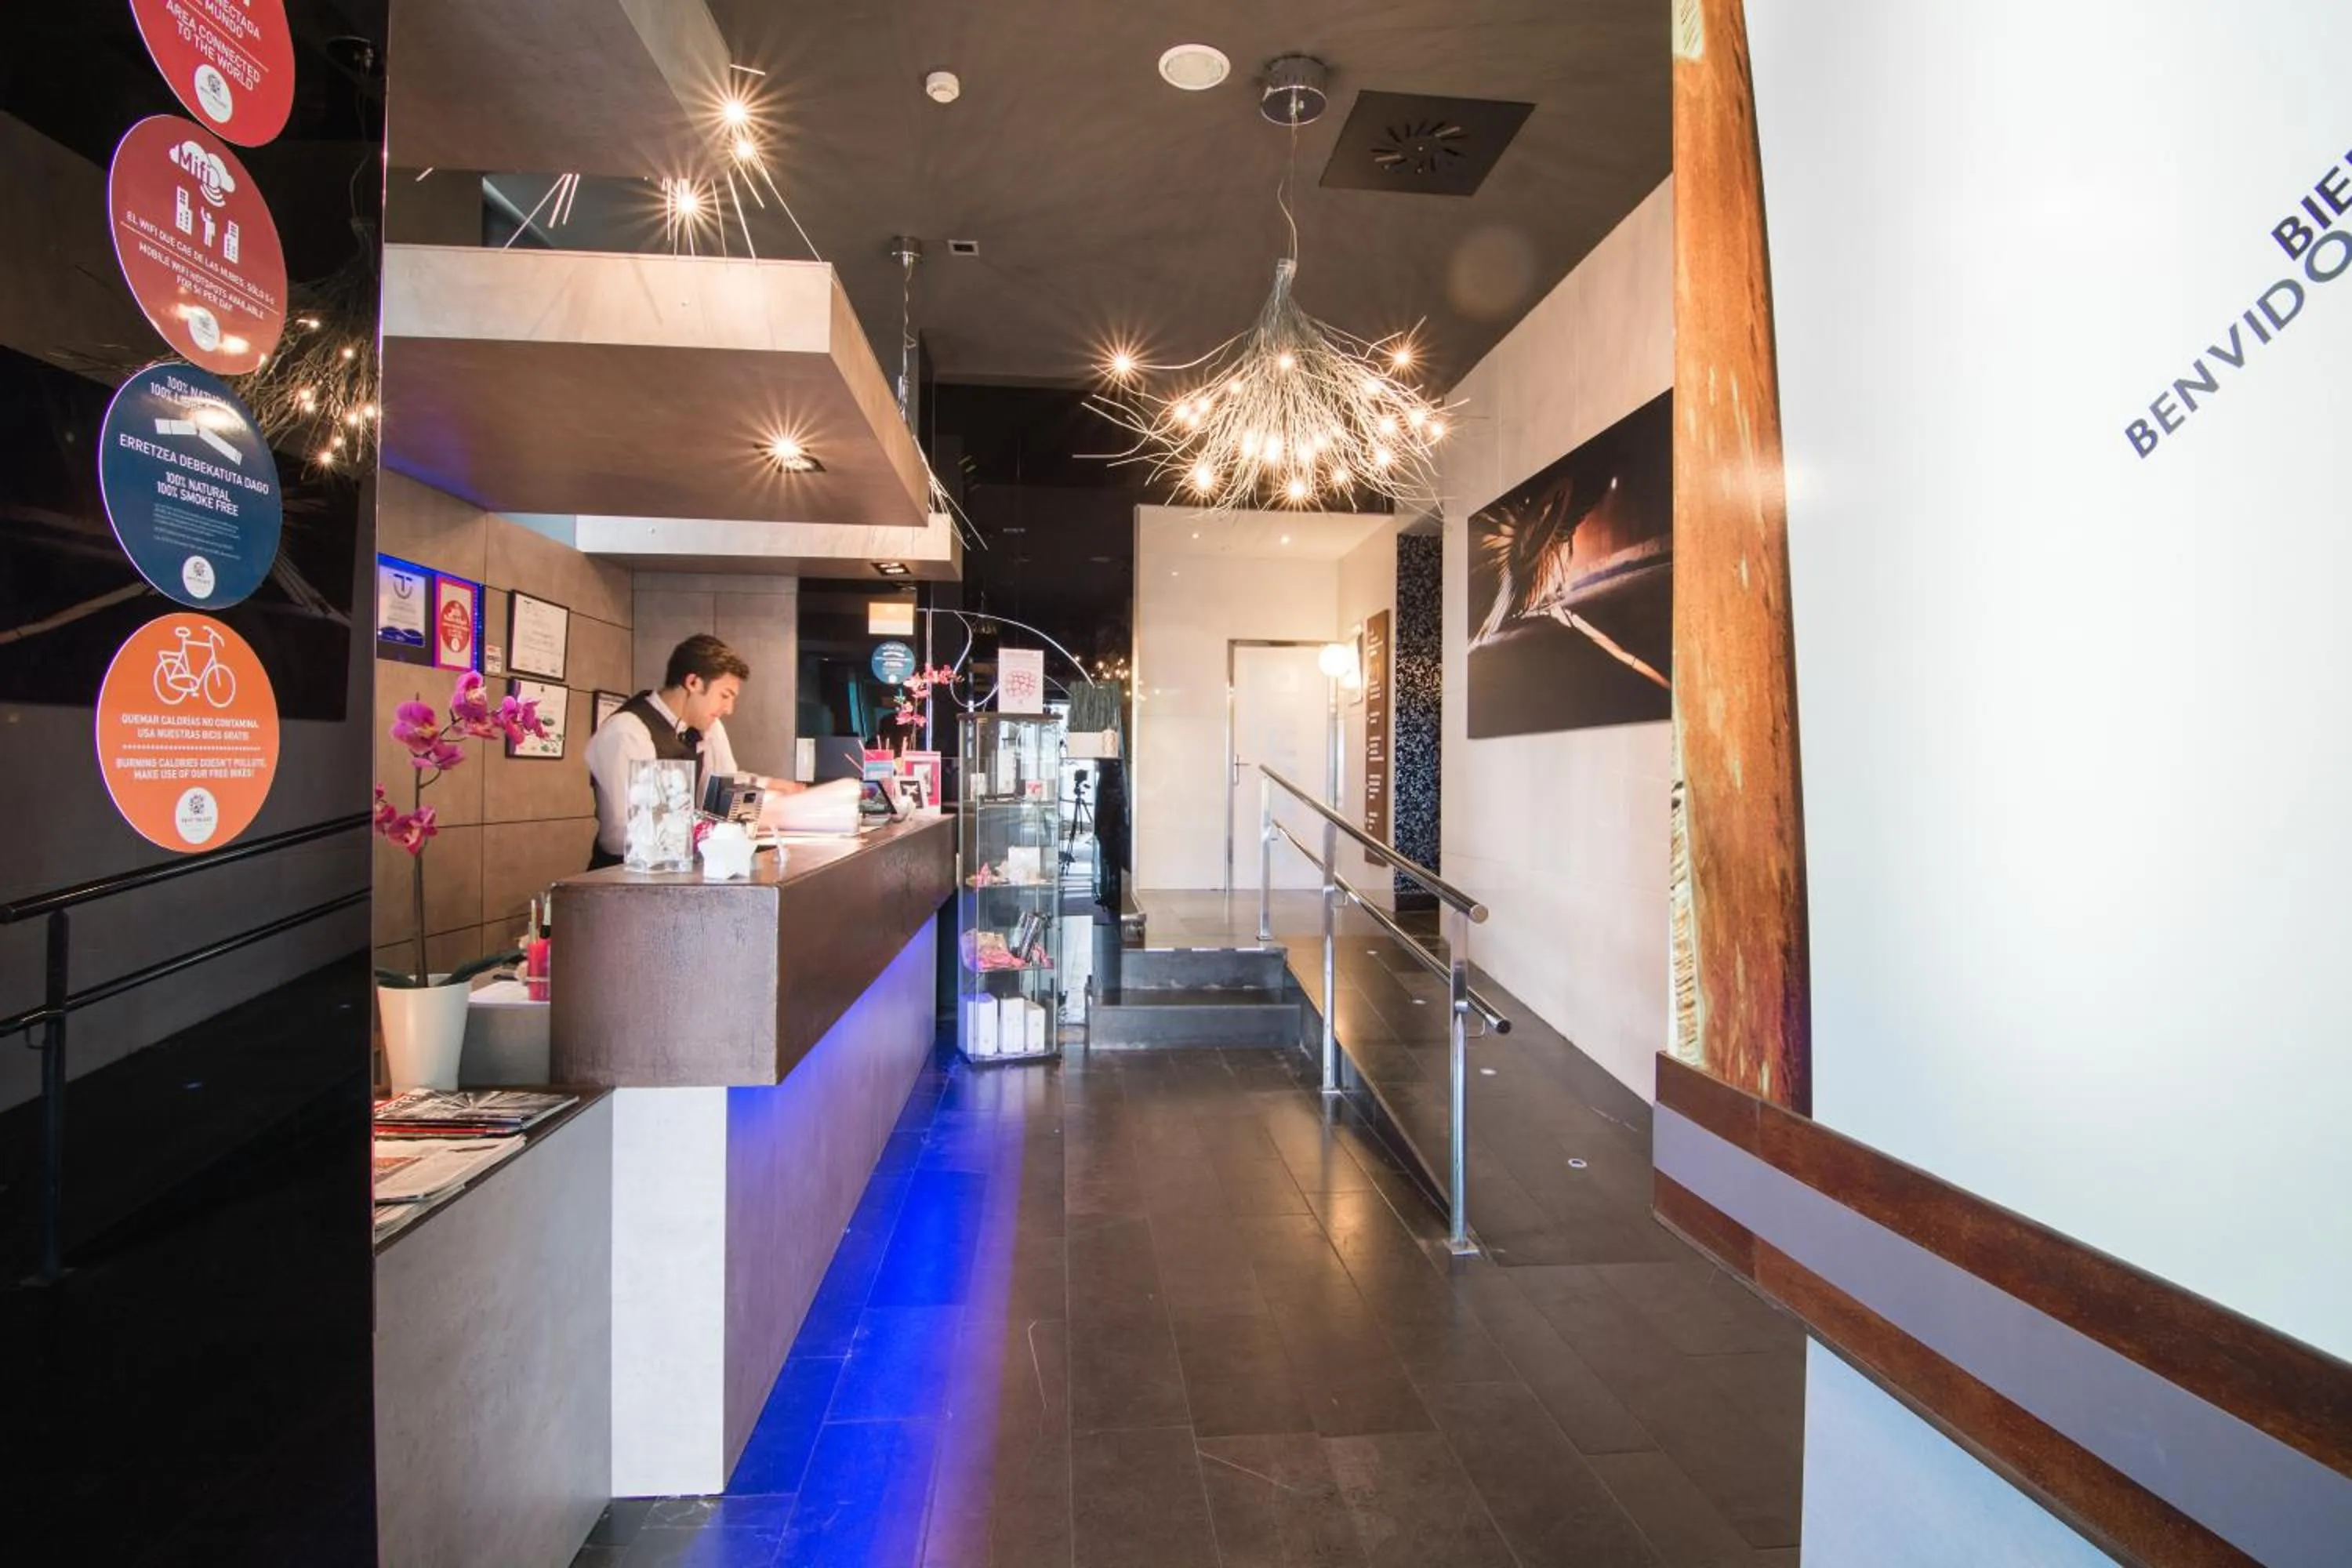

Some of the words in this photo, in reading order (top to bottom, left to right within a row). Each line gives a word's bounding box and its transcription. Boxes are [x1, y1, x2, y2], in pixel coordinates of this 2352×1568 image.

[176, 20, 191, 41] TO
[194, 33, 215, 62] THE
[217, 52, 253, 91] WORLD
[198, 24, 261, 83] CONNECTED
[2271, 149, 2352, 261] BIE
[139, 219, 158, 237] WIFI
[159, 230, 176, 248] QUE
[139, 241, 170, 267] MOBILE
[176, 274, 192, 290] FOR
[151, 382, 172, 402] 100%
[167, 376, 189, 394] 100%
[120, 434, 177, 463] ERRETZEA
[180, 454, 242, 486] DEBEKATUTA
[244, 477, 270, 495] DAGO
[157, 481, 178, 498] 100%
[180, 488, 214, 510] SMOKE
[216, 499, 239, 517] FREE
[165, 471, 187, 487] 100%
[188, 479, 232, 503] NATURAL
[122, 714, 159, 724] QUEMAR
[201, 717, 214, 727] NO
[137, 728, 155, 739] USA
[157, 728, 201, 739] NUESTRAS
[116, 757, 158, 768] BURNING
[134, 768, 159, 779] MAKE
[161, 768, 177, 779] USE
[178, 768, 190, 779] OF
[191, 768, 208, 779] OUR
[208, 768, 229, 779] FREE
